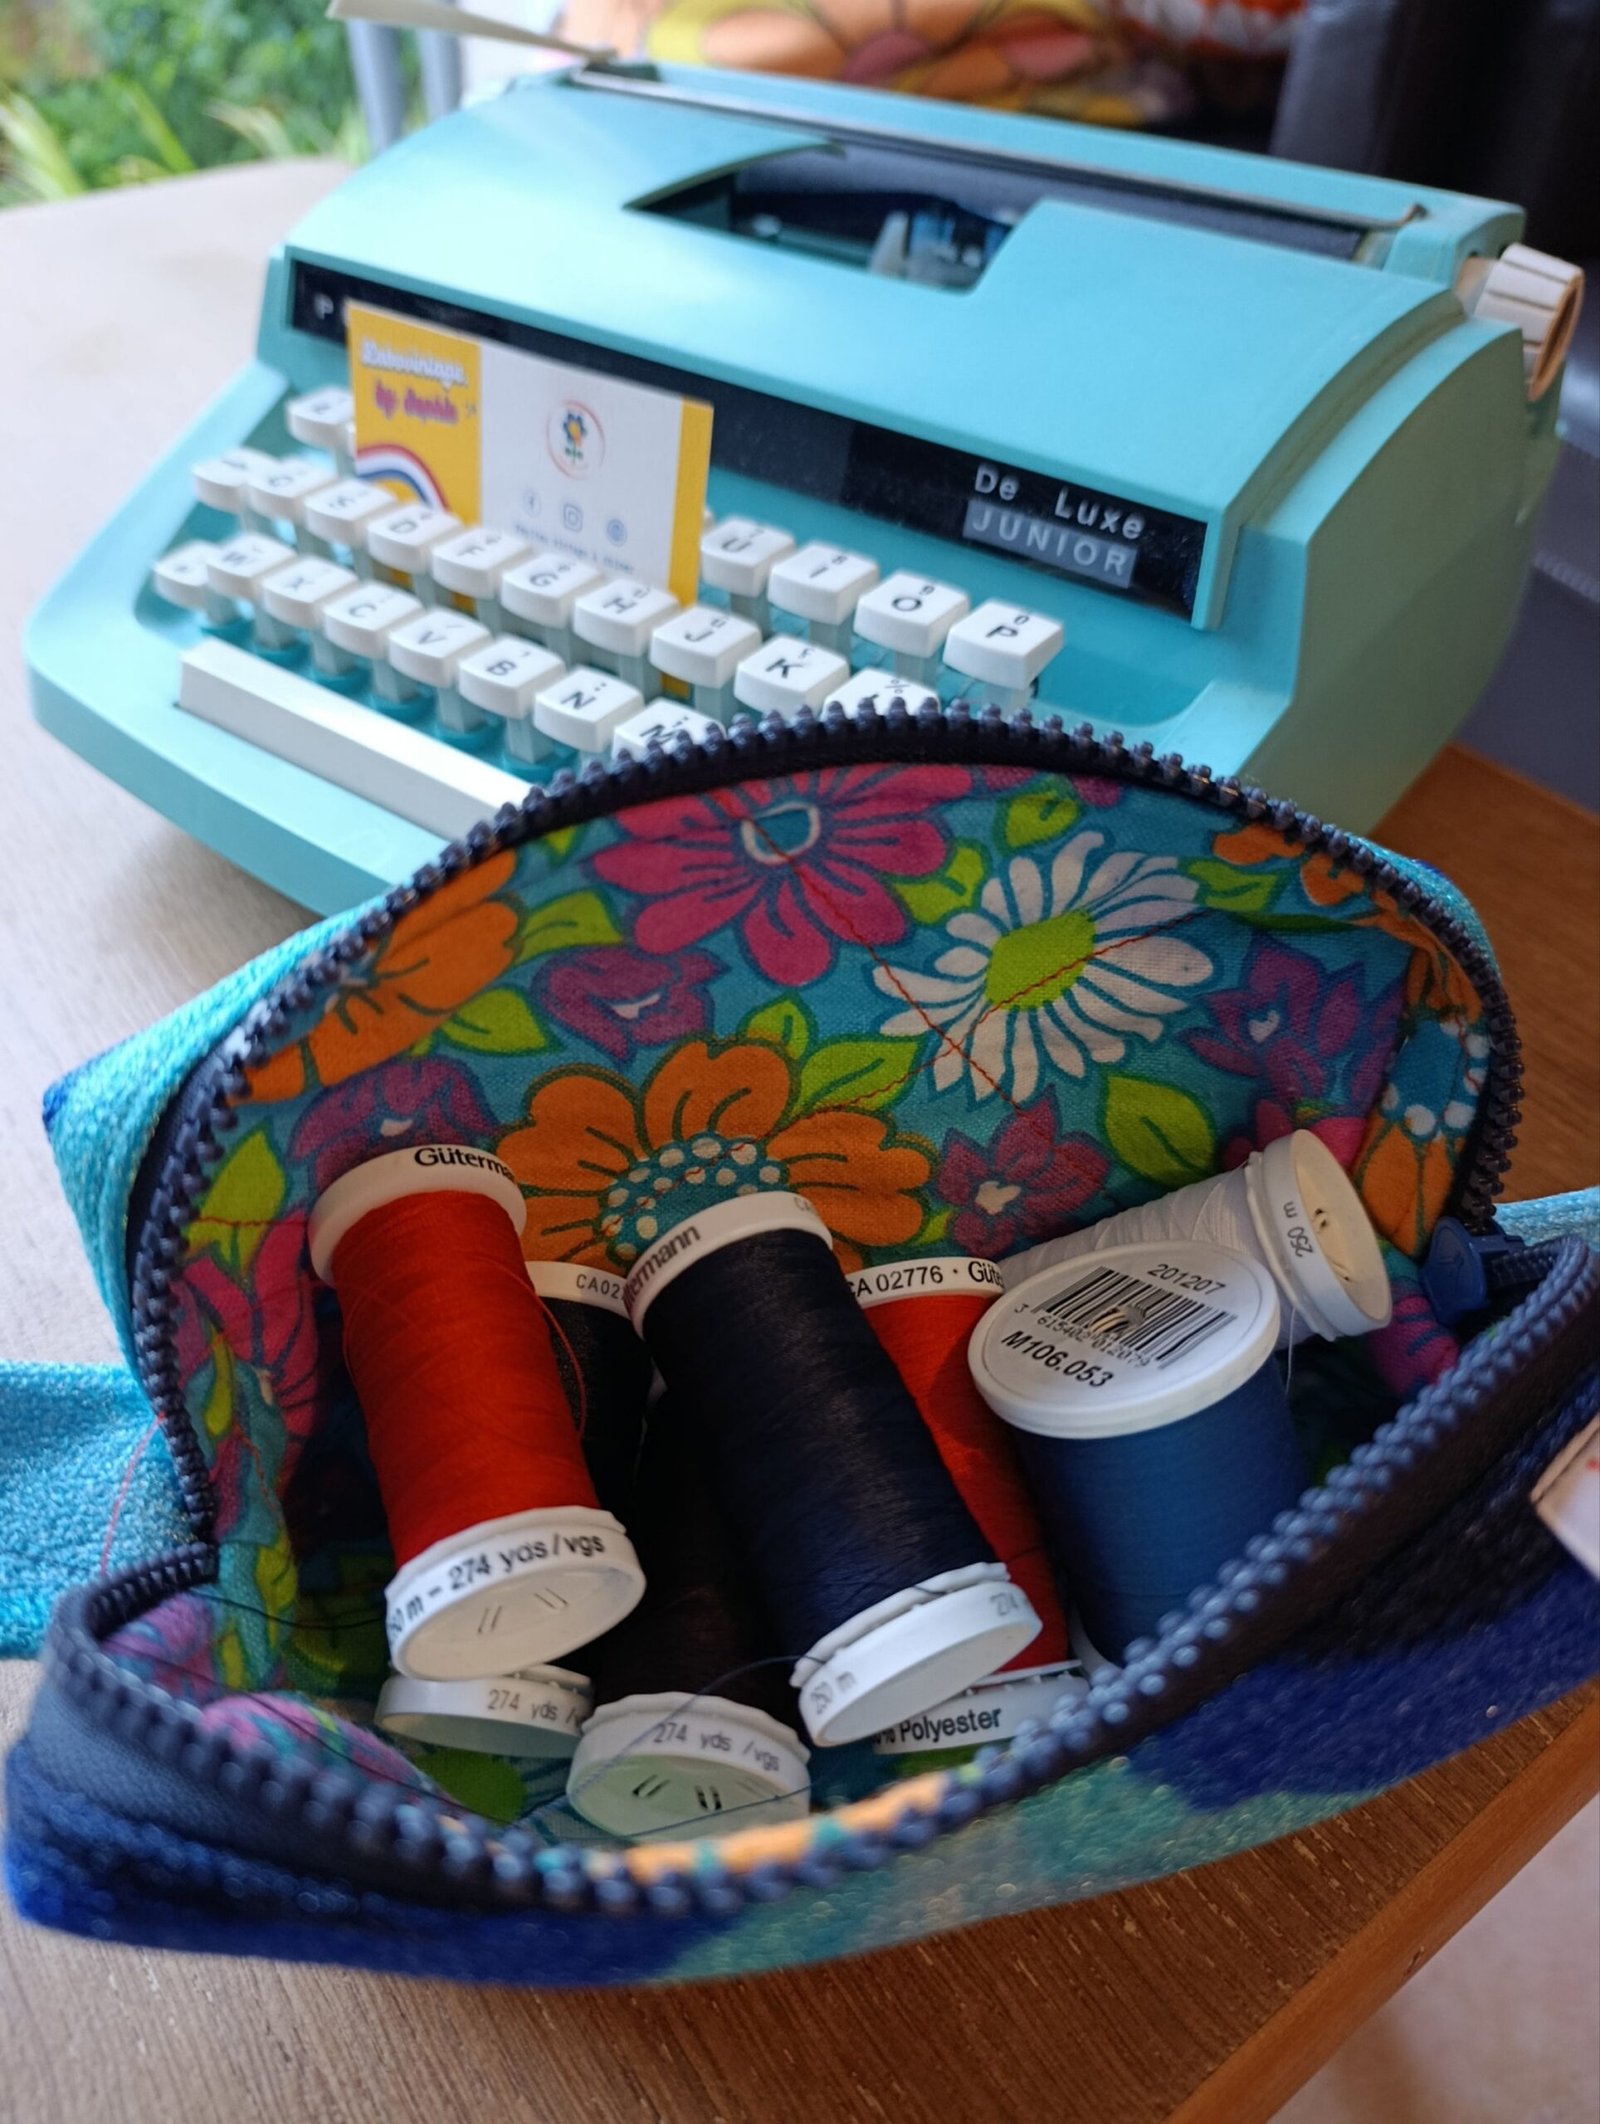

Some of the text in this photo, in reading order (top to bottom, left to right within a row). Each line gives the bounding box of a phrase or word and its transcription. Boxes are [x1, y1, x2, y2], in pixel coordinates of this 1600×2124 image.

[974, 462, 1146, 540] De Luxe
[971, 506, 1129, 577] JUNIOR
[528, 570, 561, 588] G
[602, 596, 639, 616] H
[890, 596, 924, 612] O
[684, 629, 716, 643] J
[984, 624, 1019, 639] P
[486, 660, 517, 677] B
[765, 657, 804, 680] K
[560, 690, 597, 711] N
[1282, 1200, 1314, 1258] 250 m
[575, 1272, 625, 1302] CA02
[875, 1265, 944, 1293] 02776
[1146, 1263, 1227, 1296] 201207
[1000, 1330, 1114, 1388] M106.053
[449, 1554, 491, 1591] 274
[487, 1688, 521, 1712] 274
[653, 1722, 688, 1745] 274
[899, 1708, 1003, 1744] Polyester
